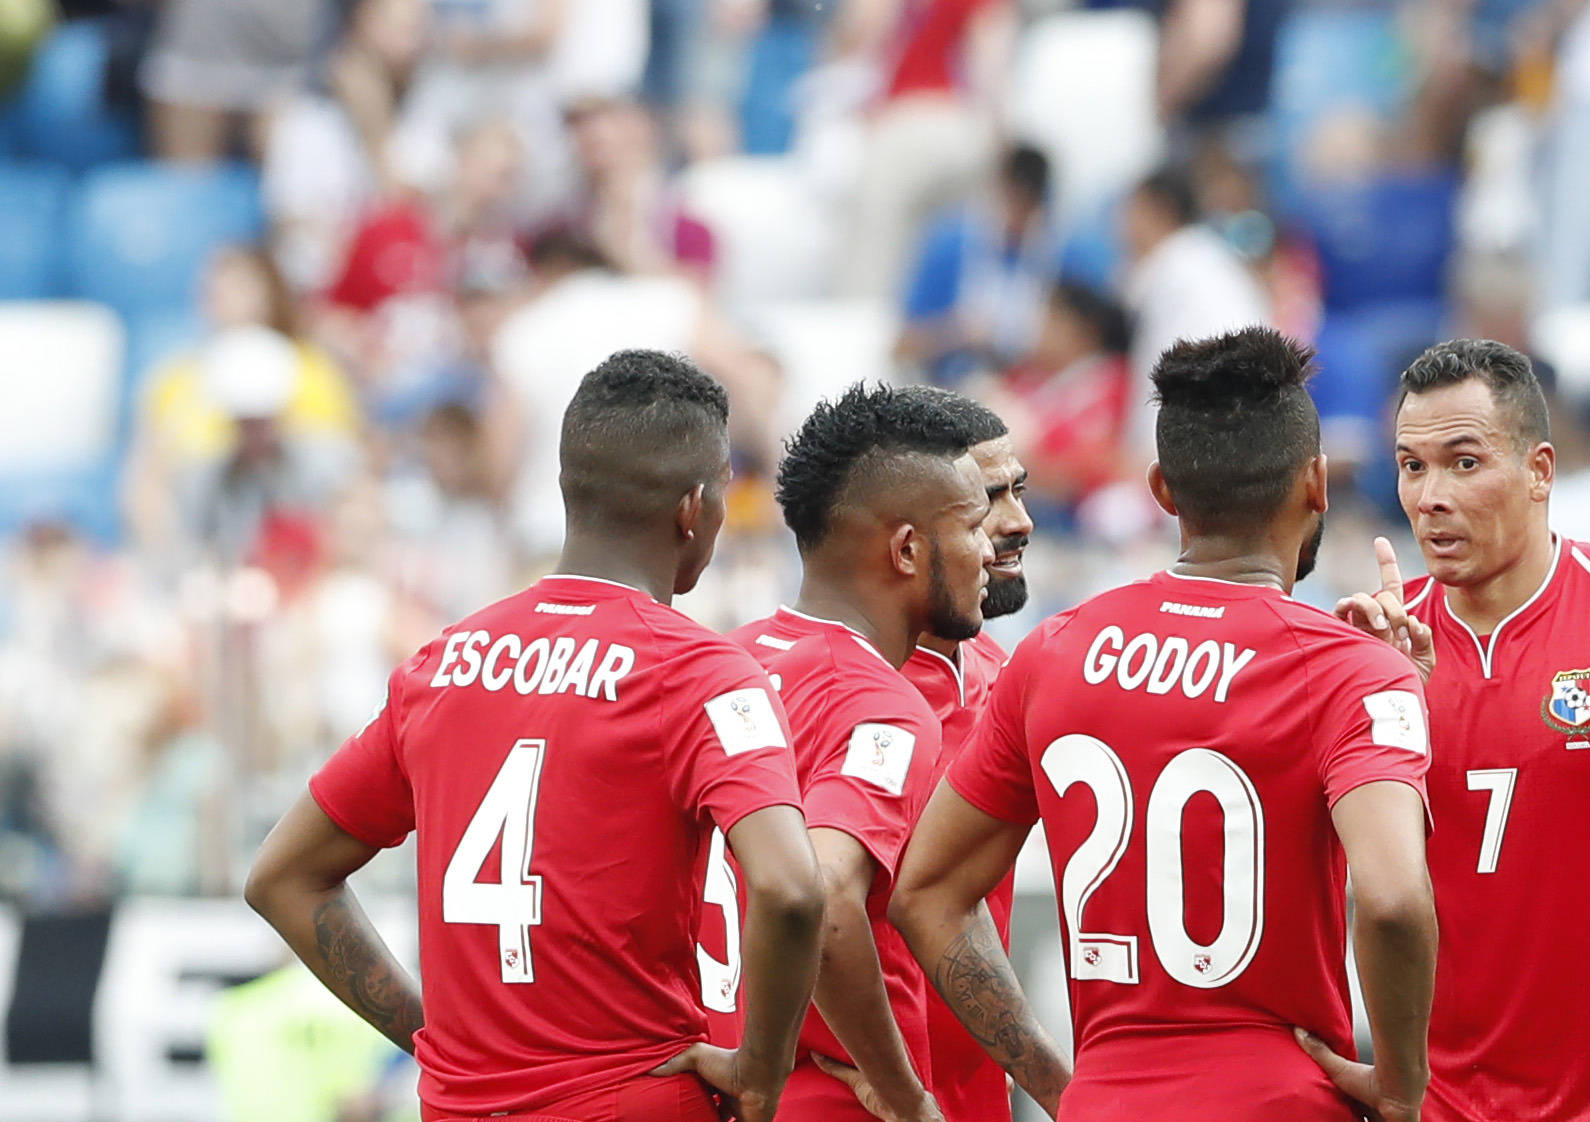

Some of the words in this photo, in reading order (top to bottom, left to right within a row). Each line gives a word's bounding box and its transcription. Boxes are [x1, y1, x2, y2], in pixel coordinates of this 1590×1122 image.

[431, 630, 635, 702] ESCOBAR
[1083, 625, 1257, 703] GODOY
[443, 738, 545, 983] 4
[1040, 734, 1264, 989] 20
[1466, 768, 1518, 873] 7
